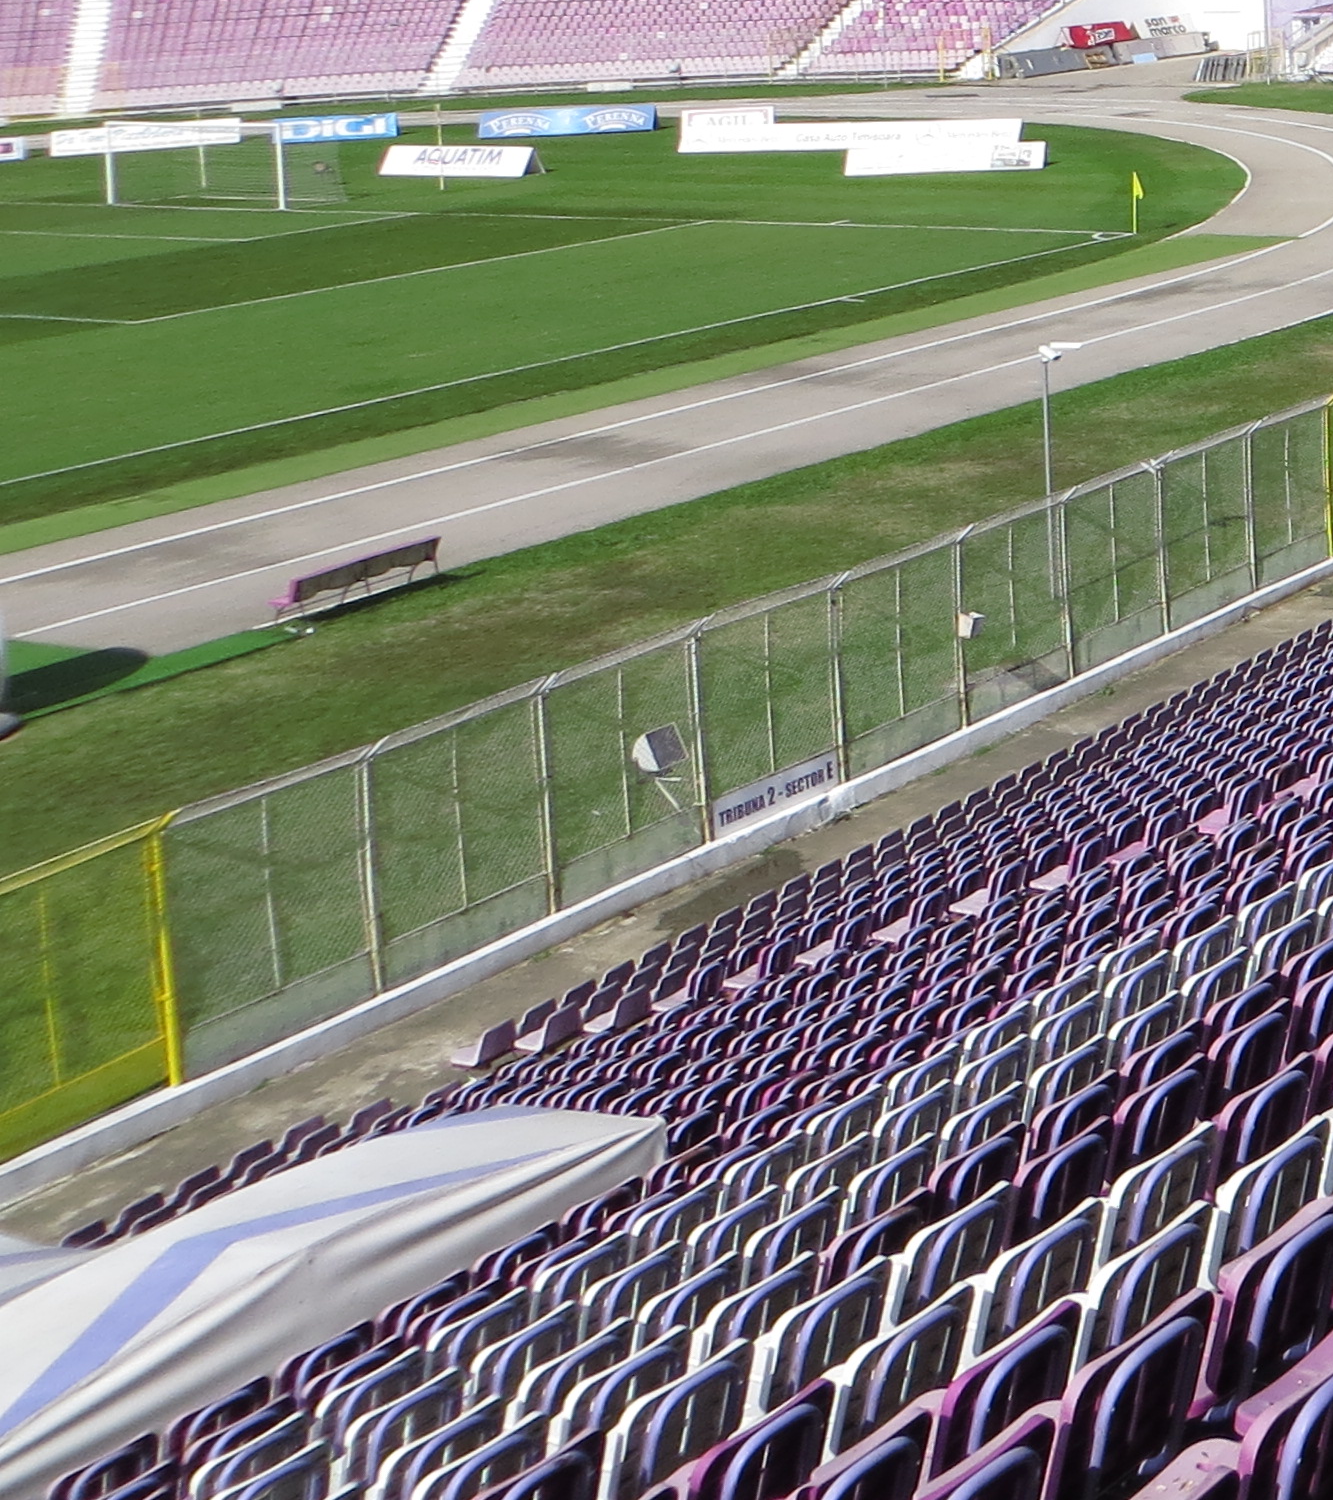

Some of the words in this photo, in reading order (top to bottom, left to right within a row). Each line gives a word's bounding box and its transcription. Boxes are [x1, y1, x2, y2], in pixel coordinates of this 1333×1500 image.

[1145, 17, 1167, 27] san
[1150, 25, 1187, 37] marco
[413, 147, 503, 166] AQUATIM
[718, 794, 766, 827] TRIBUNA
[767, 786, 776, 806] 2
[785, 768, 825, 798] SECTOR
[826, 760, 834, 779] E
